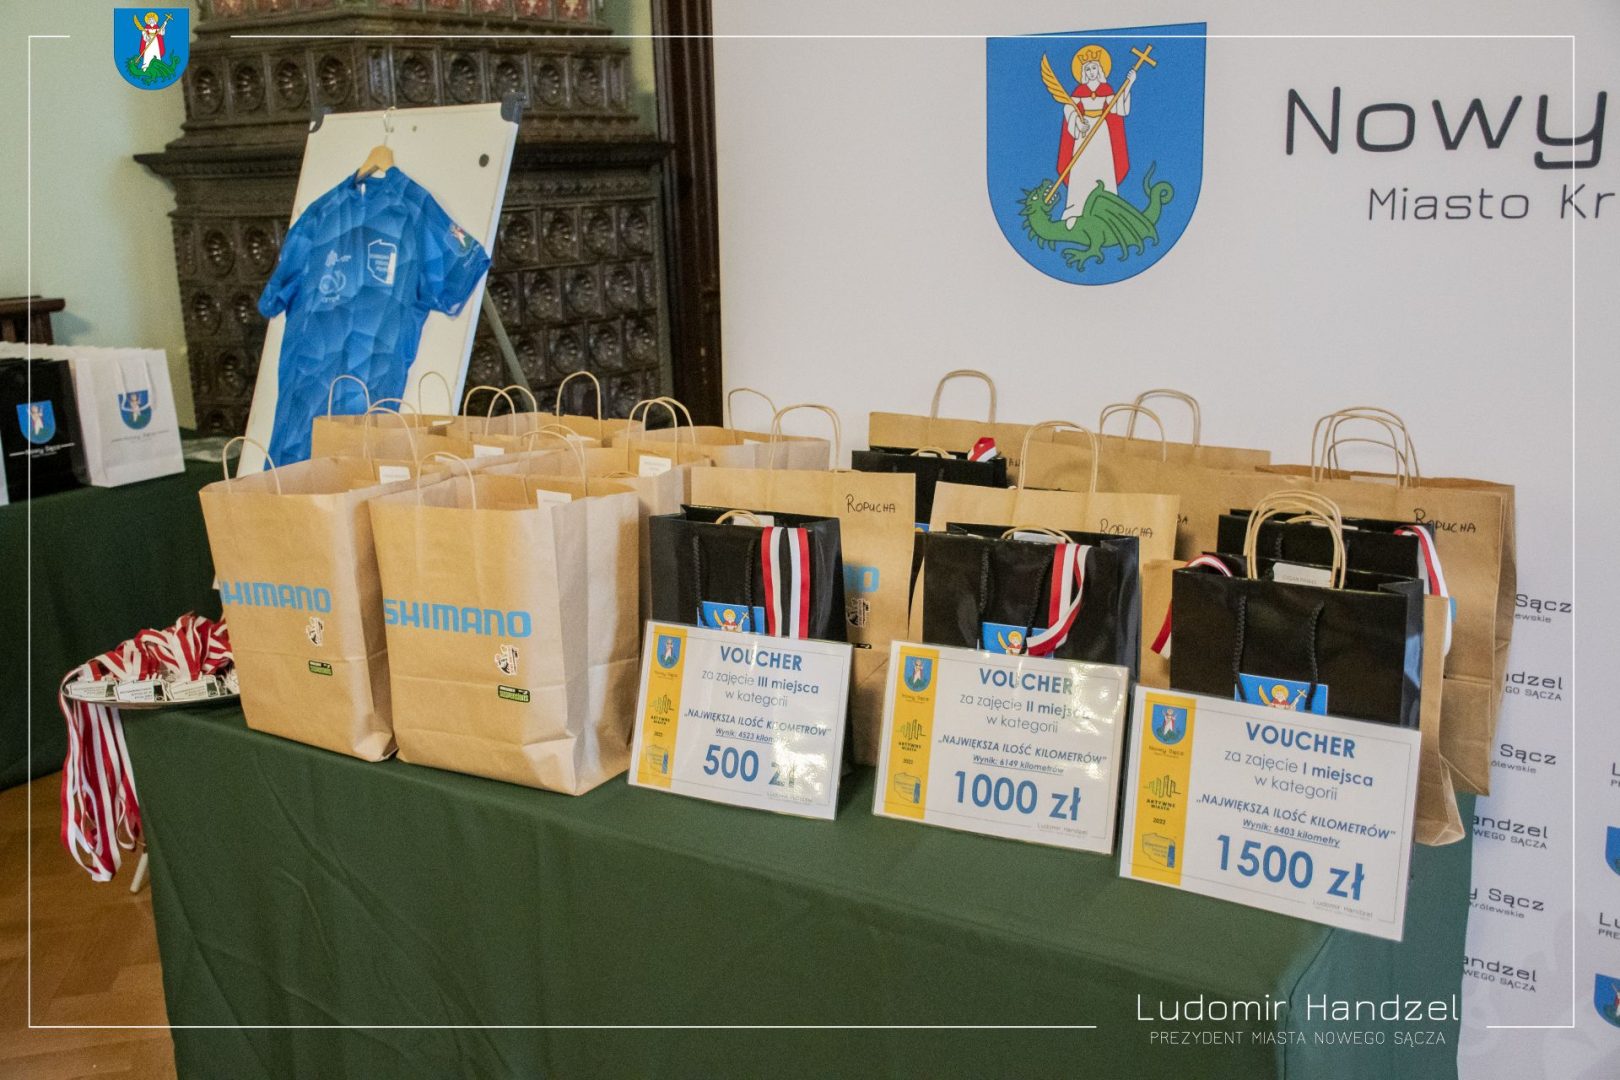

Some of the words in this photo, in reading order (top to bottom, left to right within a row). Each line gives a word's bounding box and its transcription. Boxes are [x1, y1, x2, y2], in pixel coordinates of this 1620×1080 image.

[1286, 86, 1608, 170] Nowy
[1368, 187, 1530, 221] Miasto
[1560, 183, 1616, 220] Kr
[221, 580, 332, 614] HIMANO
[1515, 593, 1573, 614] Sącz
[384, 598, 533, 638] SHIMANO
[720, 645, 803, 671] VOUCHER
[702, 670, 714, 680] za
[716, 671, 755, 686] zajęcie
[757, 676, 768, 688] III
[771, 677, 819, 695] miejsca
[979, 667, 1073, 695] VOUCHER
[725, 690, 735, 699] w
[737, 690, 788, 708] kategorii
[960, 694, 974, 705] za
[977, 695, 1022, 712] zajęcie
[1026, 701, 1034, 712] II
[1524, 688, 1562, 702] SĄCZA
[737, 715, 764, 729] ILOŚĆ
[986, 715, 997, 725] w
[1001, 714, 1059, 734] kategorii
[1002, 741, 1033, 757] ILOŚĆ
[1245, 721, 1356, 759] VOUCHER
[703, 744, 760, 782] 500
[1000, 758, 1019, 769] 6149
[1499, 743, 1557, 766] Sącz
[1224, 750, 1241, 763] za
[1245, 752, 1298, 774] zajęcie
[1311, 765, 1374, 788] miejsca
[955, 770, 1038, 815] 1000
[1049, 786, 1082, 821] zł
[1254, 775, 1267, 787] w
[1271, 776, 1338, 801] kategorii
[1272, 806, 1308, 824] ILOŚĆ
[1242, 818, 1272, 833] Wynik:
[1273, 825, 1296, 838] 6403
[1297, 829, 1341, 848] kilometry
[1510, 836, 1548, 850] SĄCZA
[1217, 834, 1314, 890] 1500
[1326, 862, 1365, 901] zł
[1488, 888, 1545, 912] Sącz
[1500, 977, 1537, 993] SĄCZA
